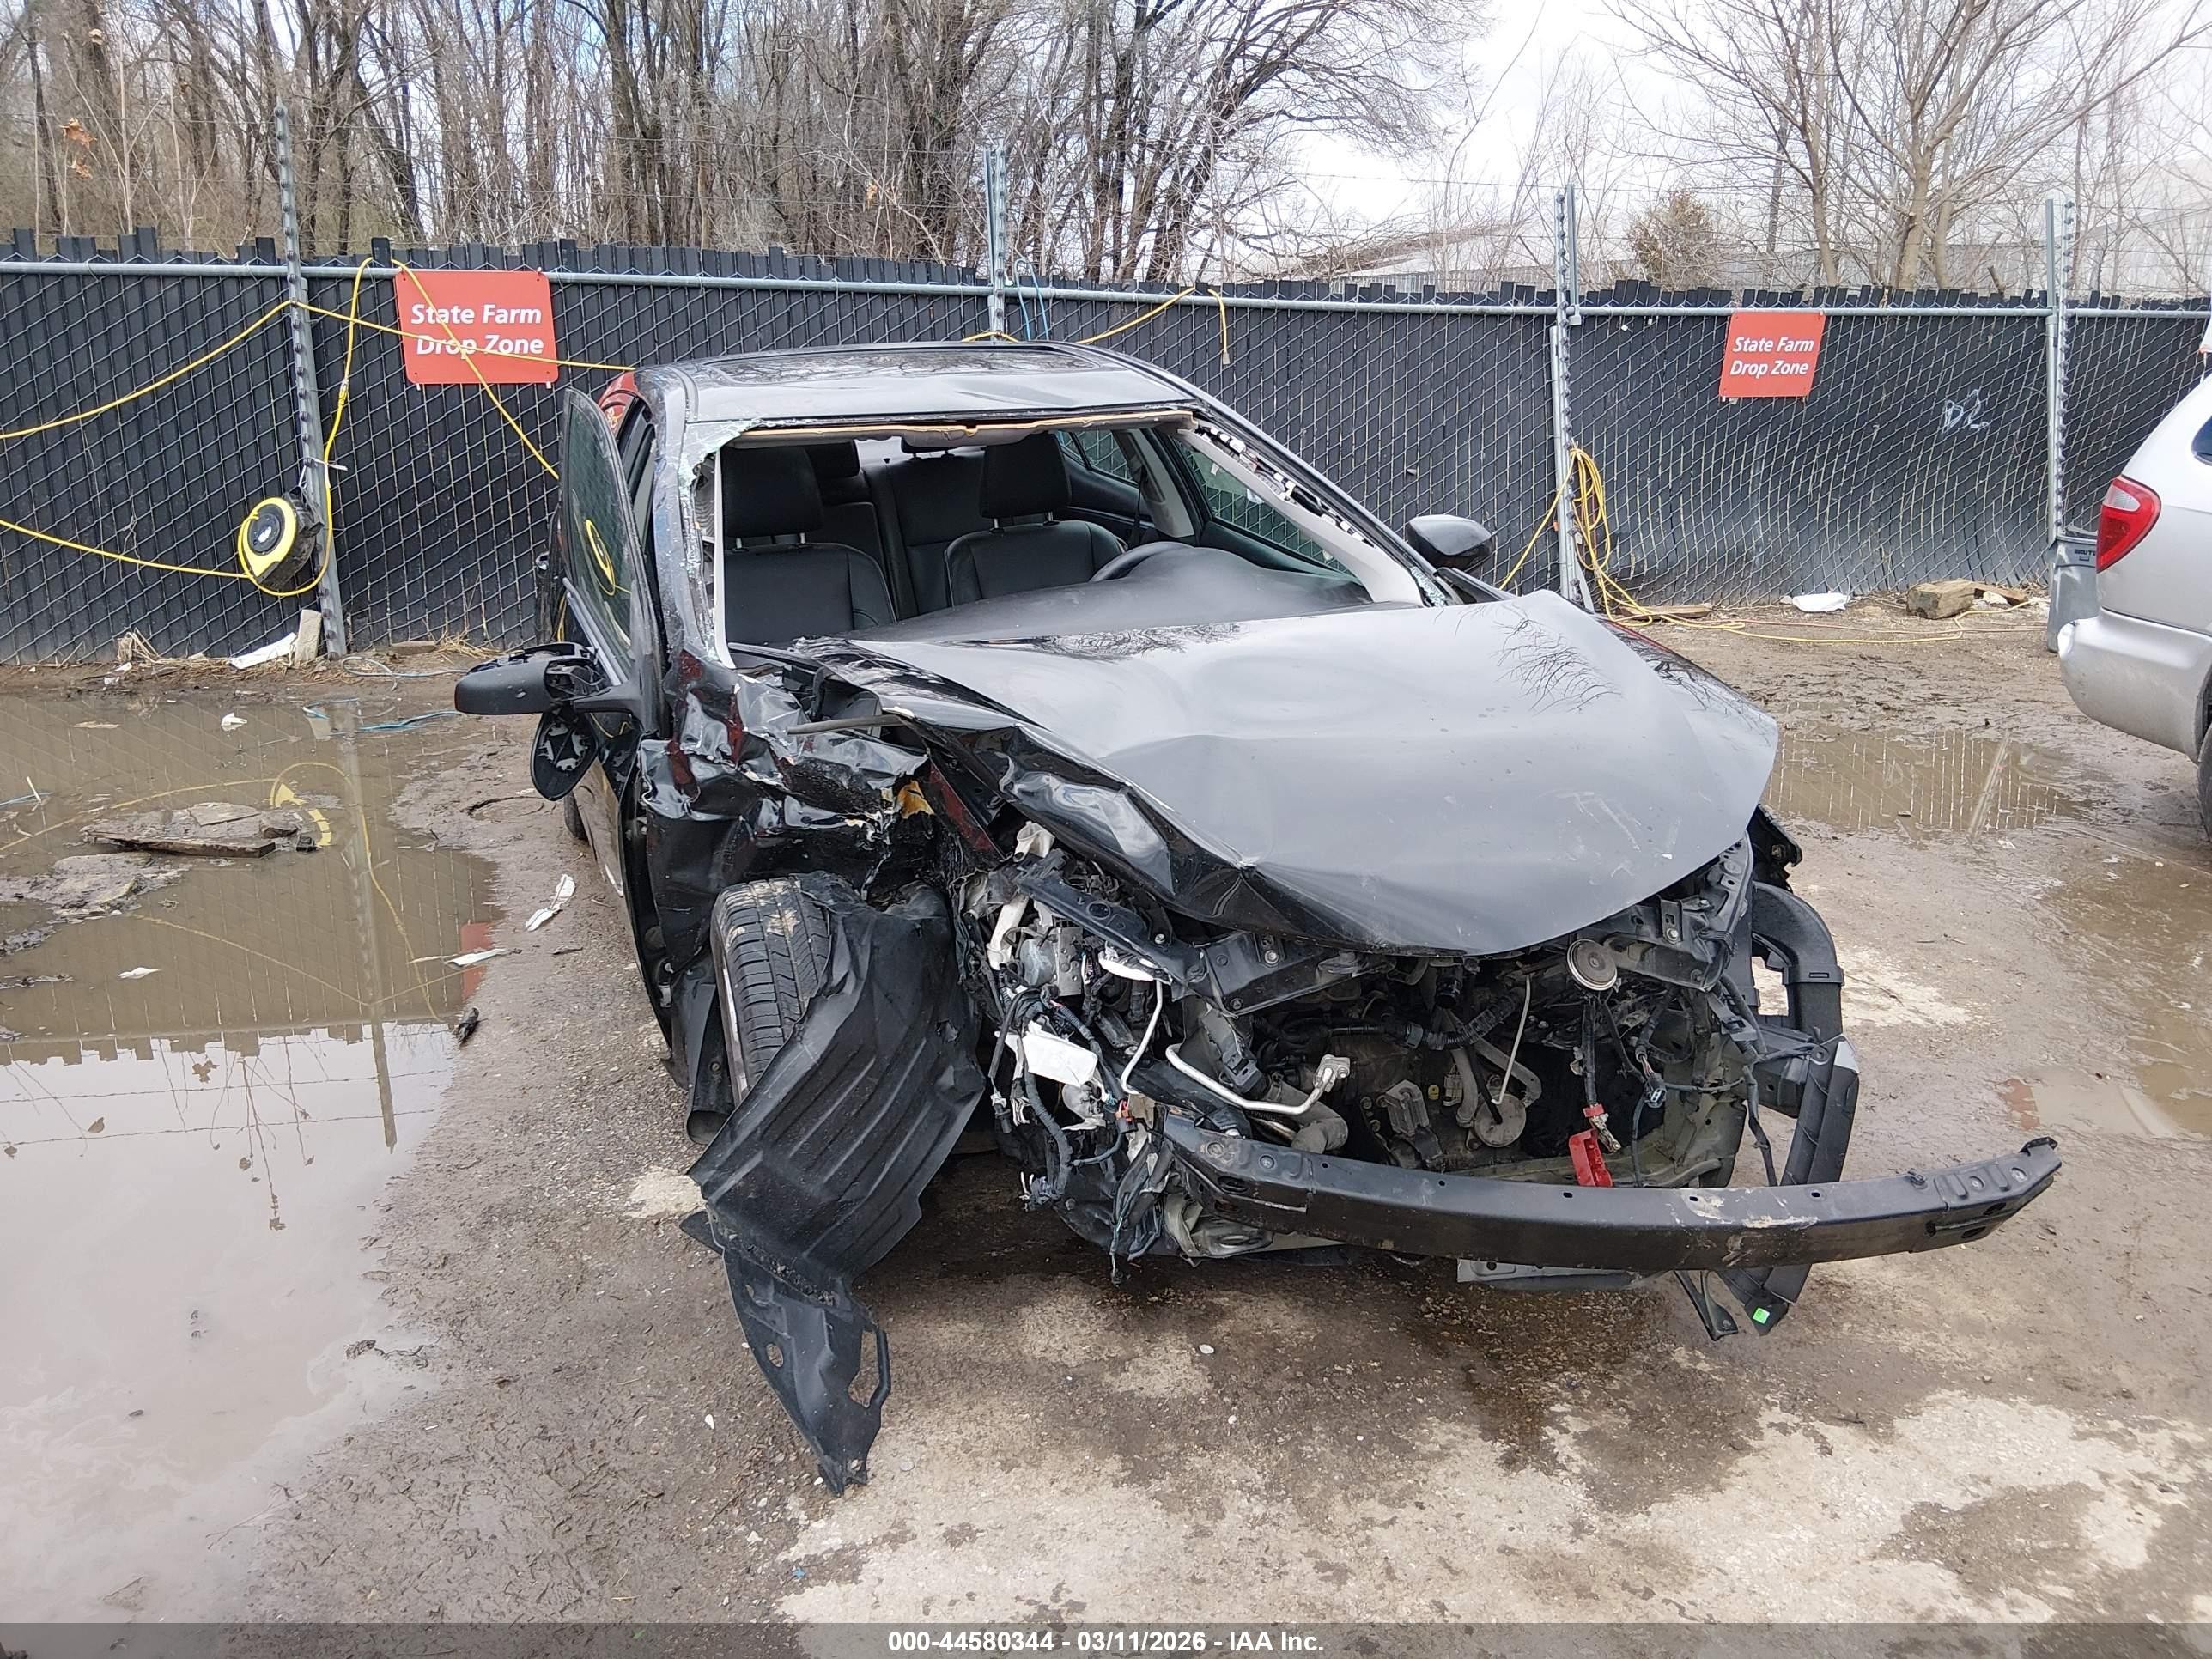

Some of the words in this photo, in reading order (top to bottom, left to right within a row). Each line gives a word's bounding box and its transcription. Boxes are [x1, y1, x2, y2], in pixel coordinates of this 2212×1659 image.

[410, 303, 475, 325] State
[483, 303, 542, 324] Farm
[416, 335, 477, 360] Drop
[484, 334, 544, 354] Zone
[1732, 336, 1774, 352] State
[1777, 337, 1814, 352] Farm
[1729, 360, 1769, 379] Drop
[1771, 359, 1809, 375] Zone
